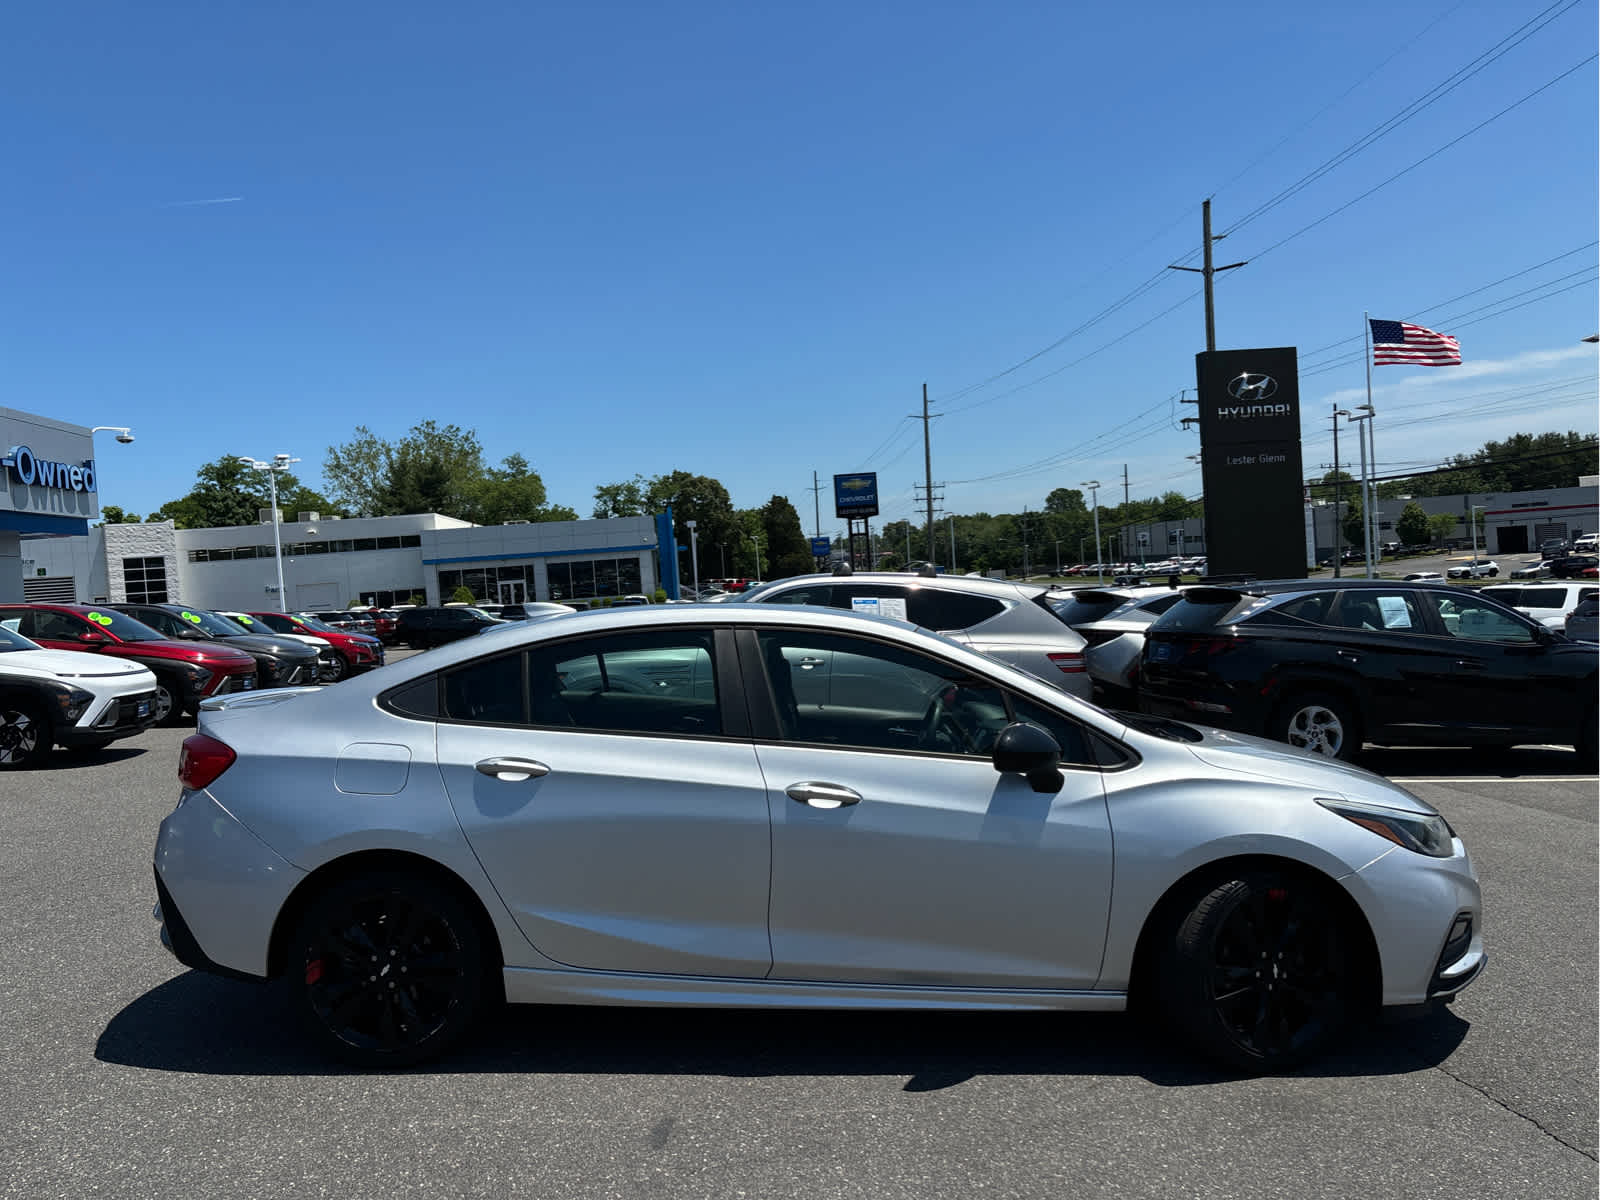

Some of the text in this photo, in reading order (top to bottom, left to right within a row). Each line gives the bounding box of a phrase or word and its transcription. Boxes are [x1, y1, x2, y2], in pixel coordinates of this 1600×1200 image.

[1218, 403, 1290, 419] HYUNDAI
[1226, 453, 1286, 465] Lester Glenn
